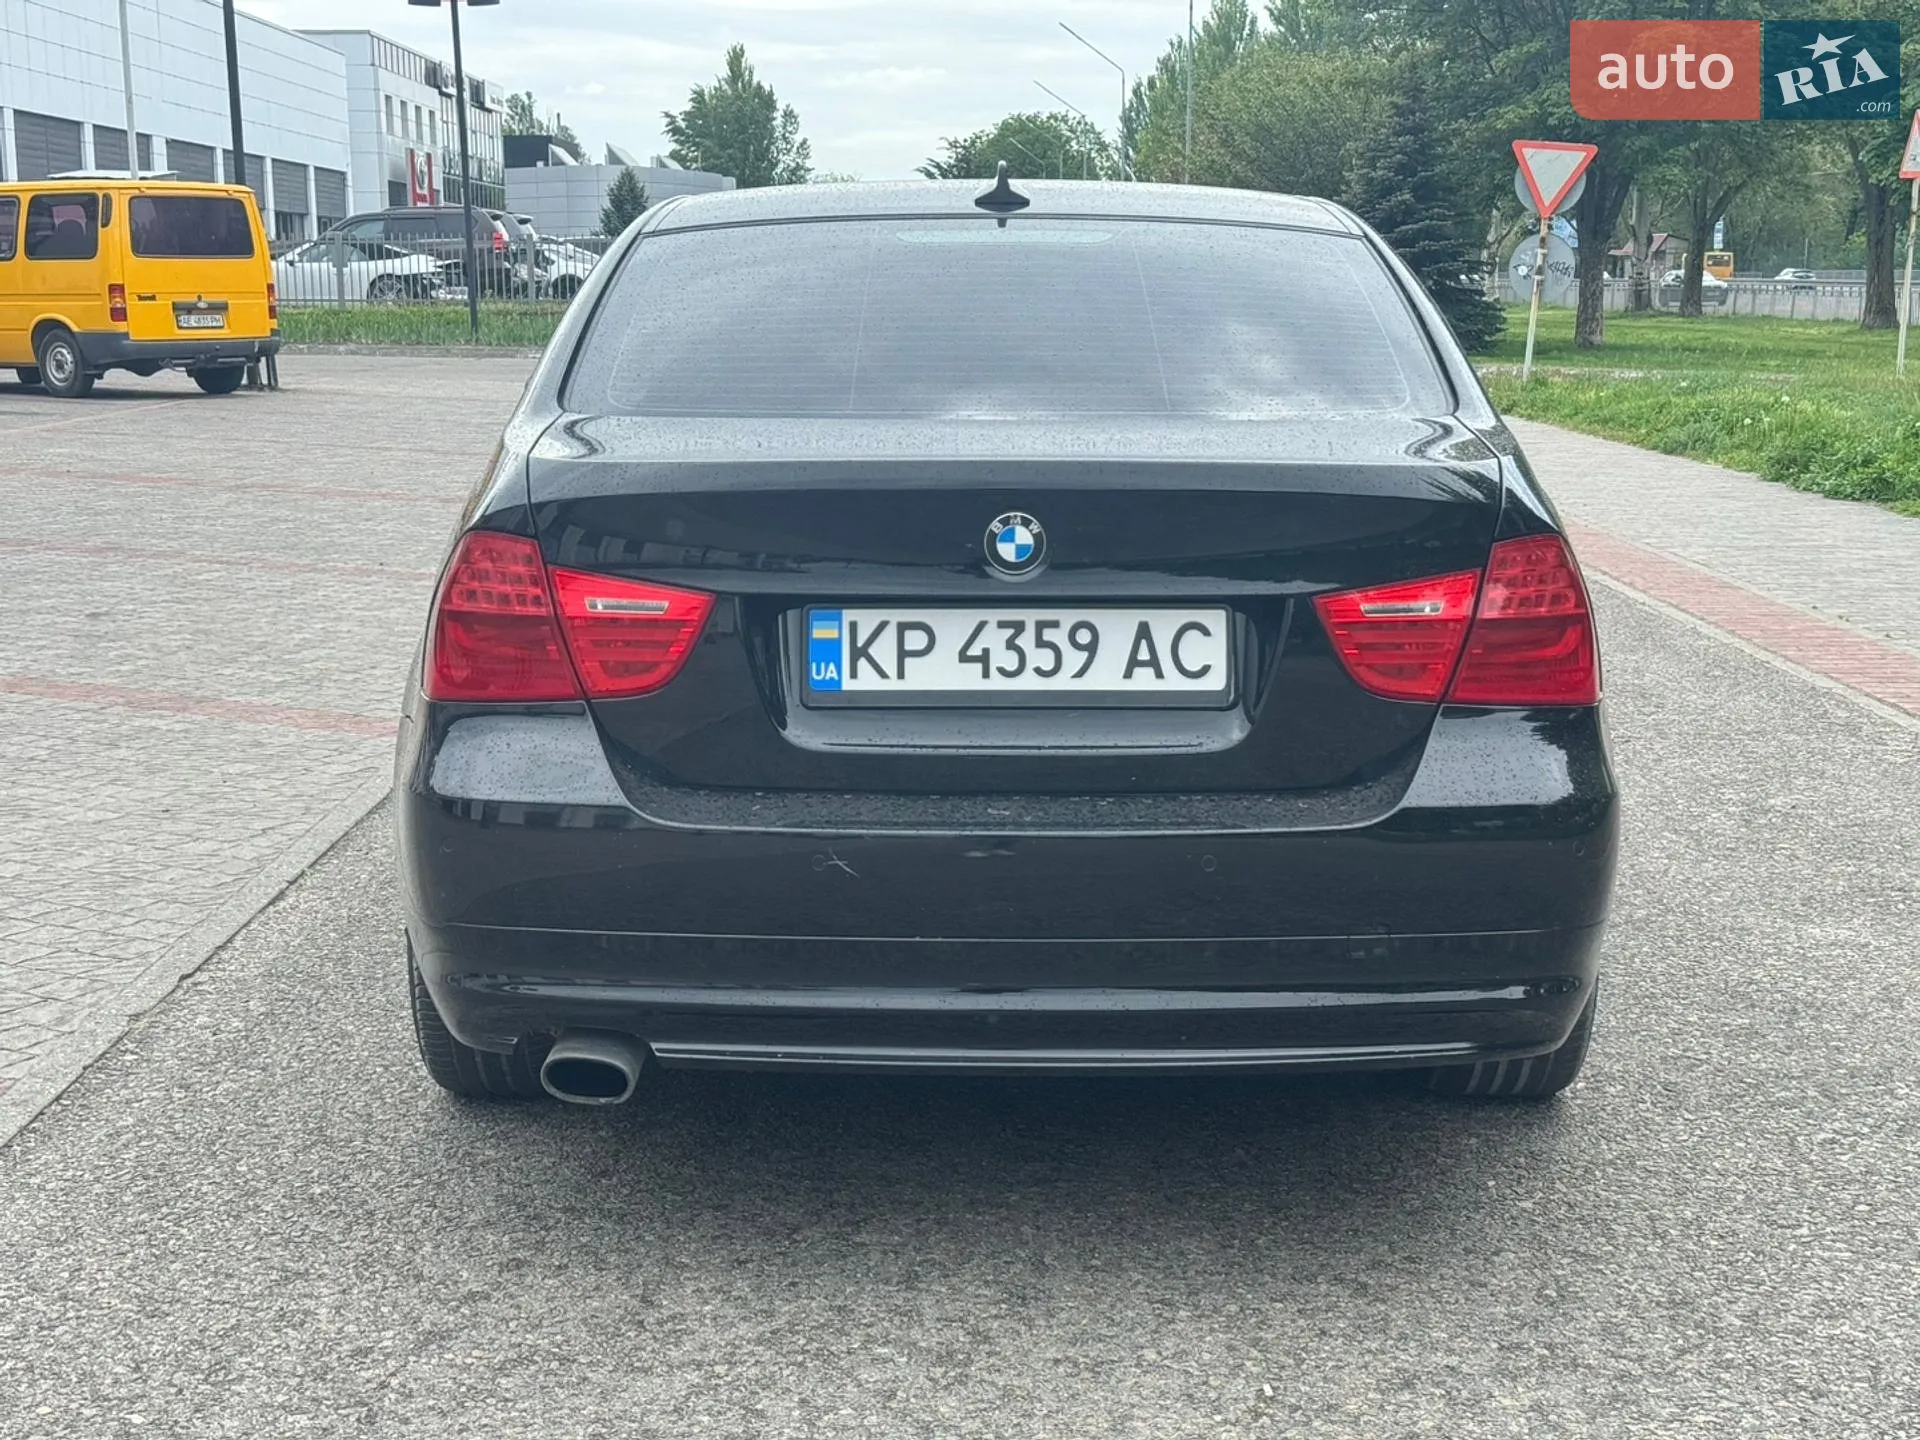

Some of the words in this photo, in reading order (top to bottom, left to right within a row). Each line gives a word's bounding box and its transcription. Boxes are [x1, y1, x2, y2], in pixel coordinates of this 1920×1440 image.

[990, 514, 1042, 534] BMW
[848, 620, 936, 680] KP
[957, 620, 1100, 680] 4359
[1122, 620, 1213, 680] AC
[812, 663, 839, 681] UA
